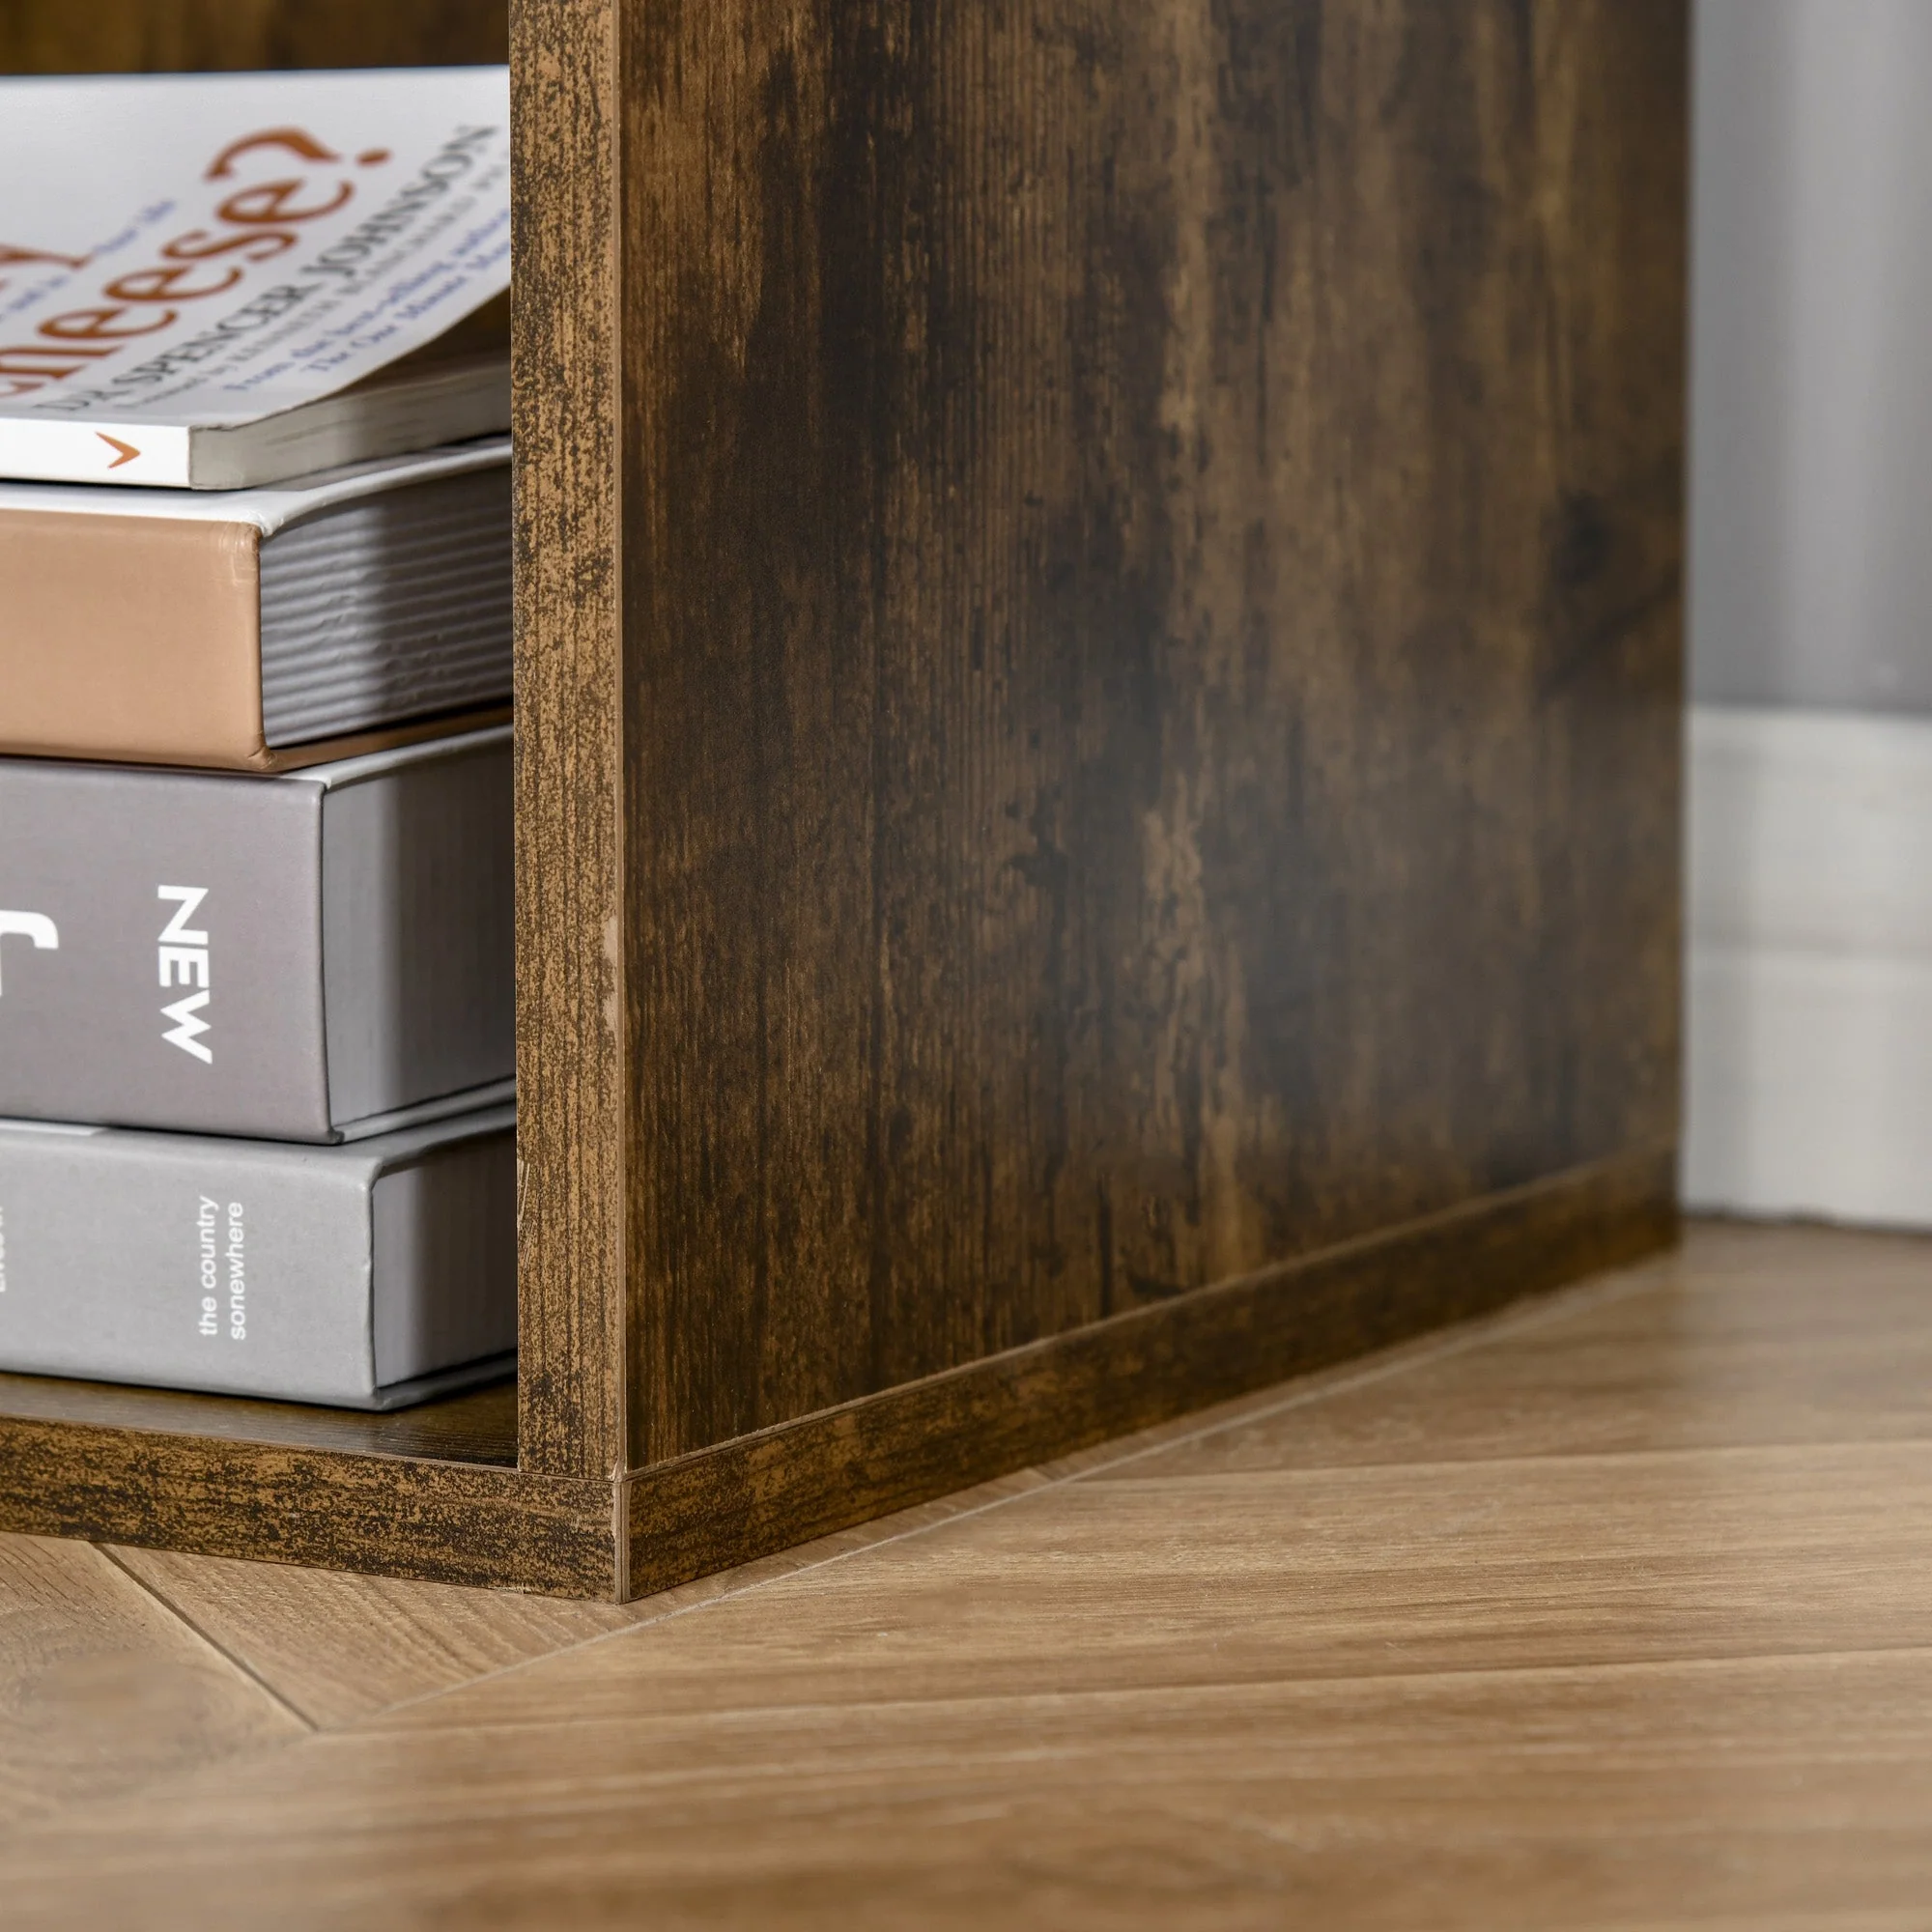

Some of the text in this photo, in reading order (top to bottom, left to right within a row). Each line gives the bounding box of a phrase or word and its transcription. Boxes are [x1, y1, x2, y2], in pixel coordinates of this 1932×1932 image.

[110, 281, 328, 384] SPENCER
[298, 126, 499, 280] JOHNSON
[157, 884, 213, 1065] NEW
[195, 1193, 220, 1336] the country
